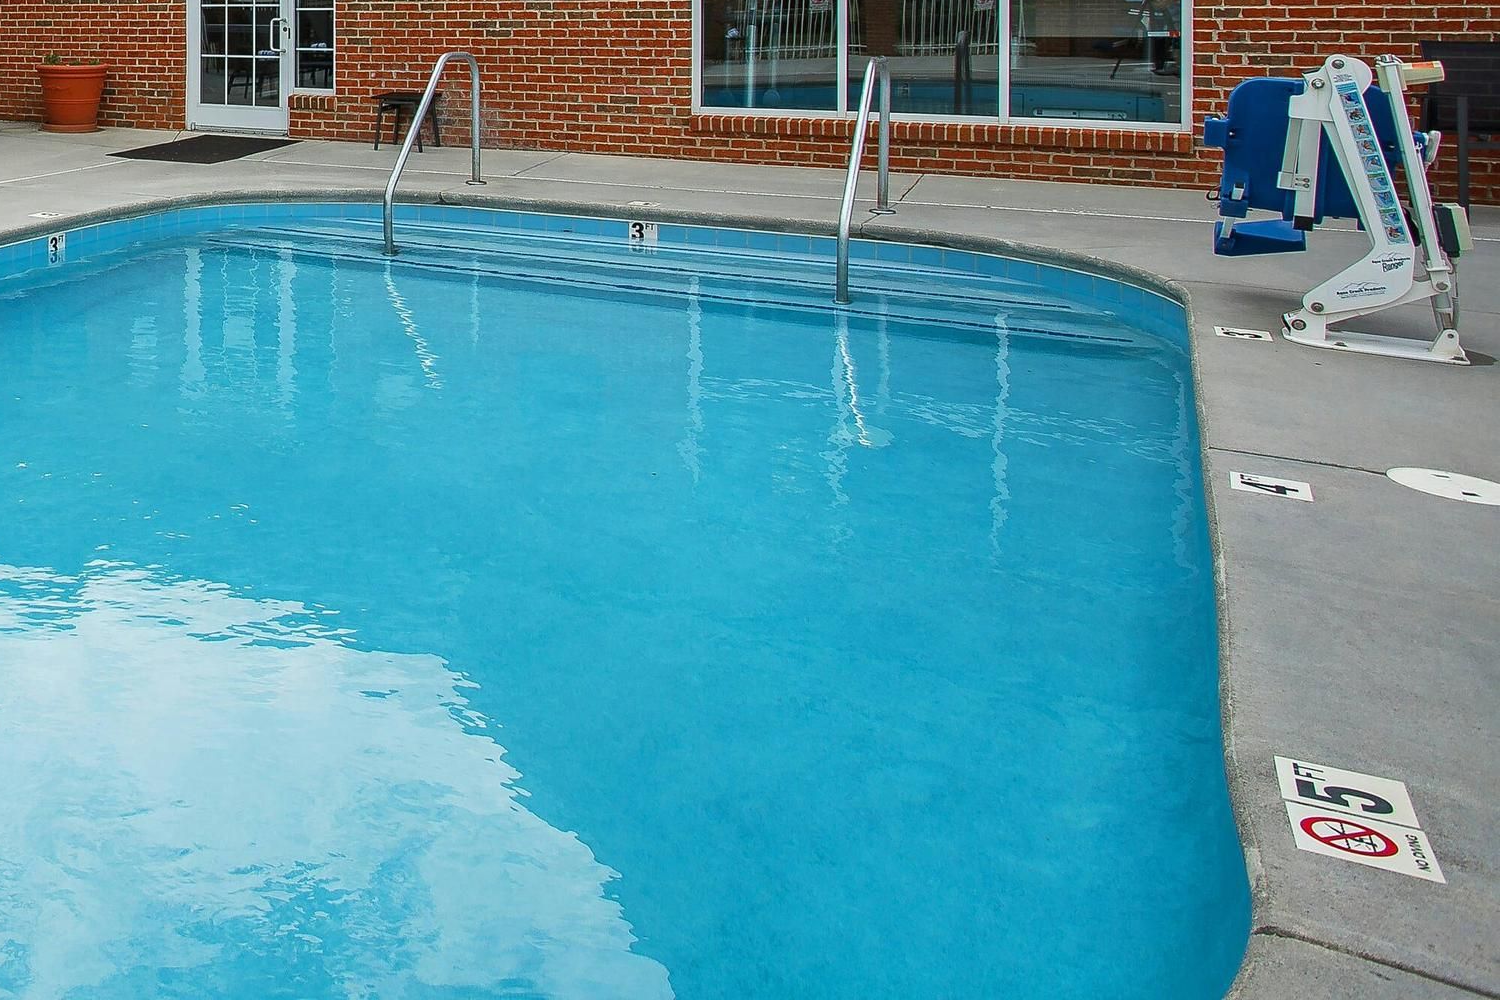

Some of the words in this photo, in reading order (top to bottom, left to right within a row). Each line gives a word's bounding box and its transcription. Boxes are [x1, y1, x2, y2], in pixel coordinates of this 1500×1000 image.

[631, 222, 644, 239] 3
[50, 236, 58, 252] 3
[1382, 261, 1404, 272] Ranger
[1222, 331, 1263, 339] 3
[1240, 480, 1299, 495] 4
[1292, 762, 1326, 782] FT
[1294, 778, 1394, 815] 5
[1405, 833, 1426, 859] DIVING
[1416, 859, 1432, 873] NO
